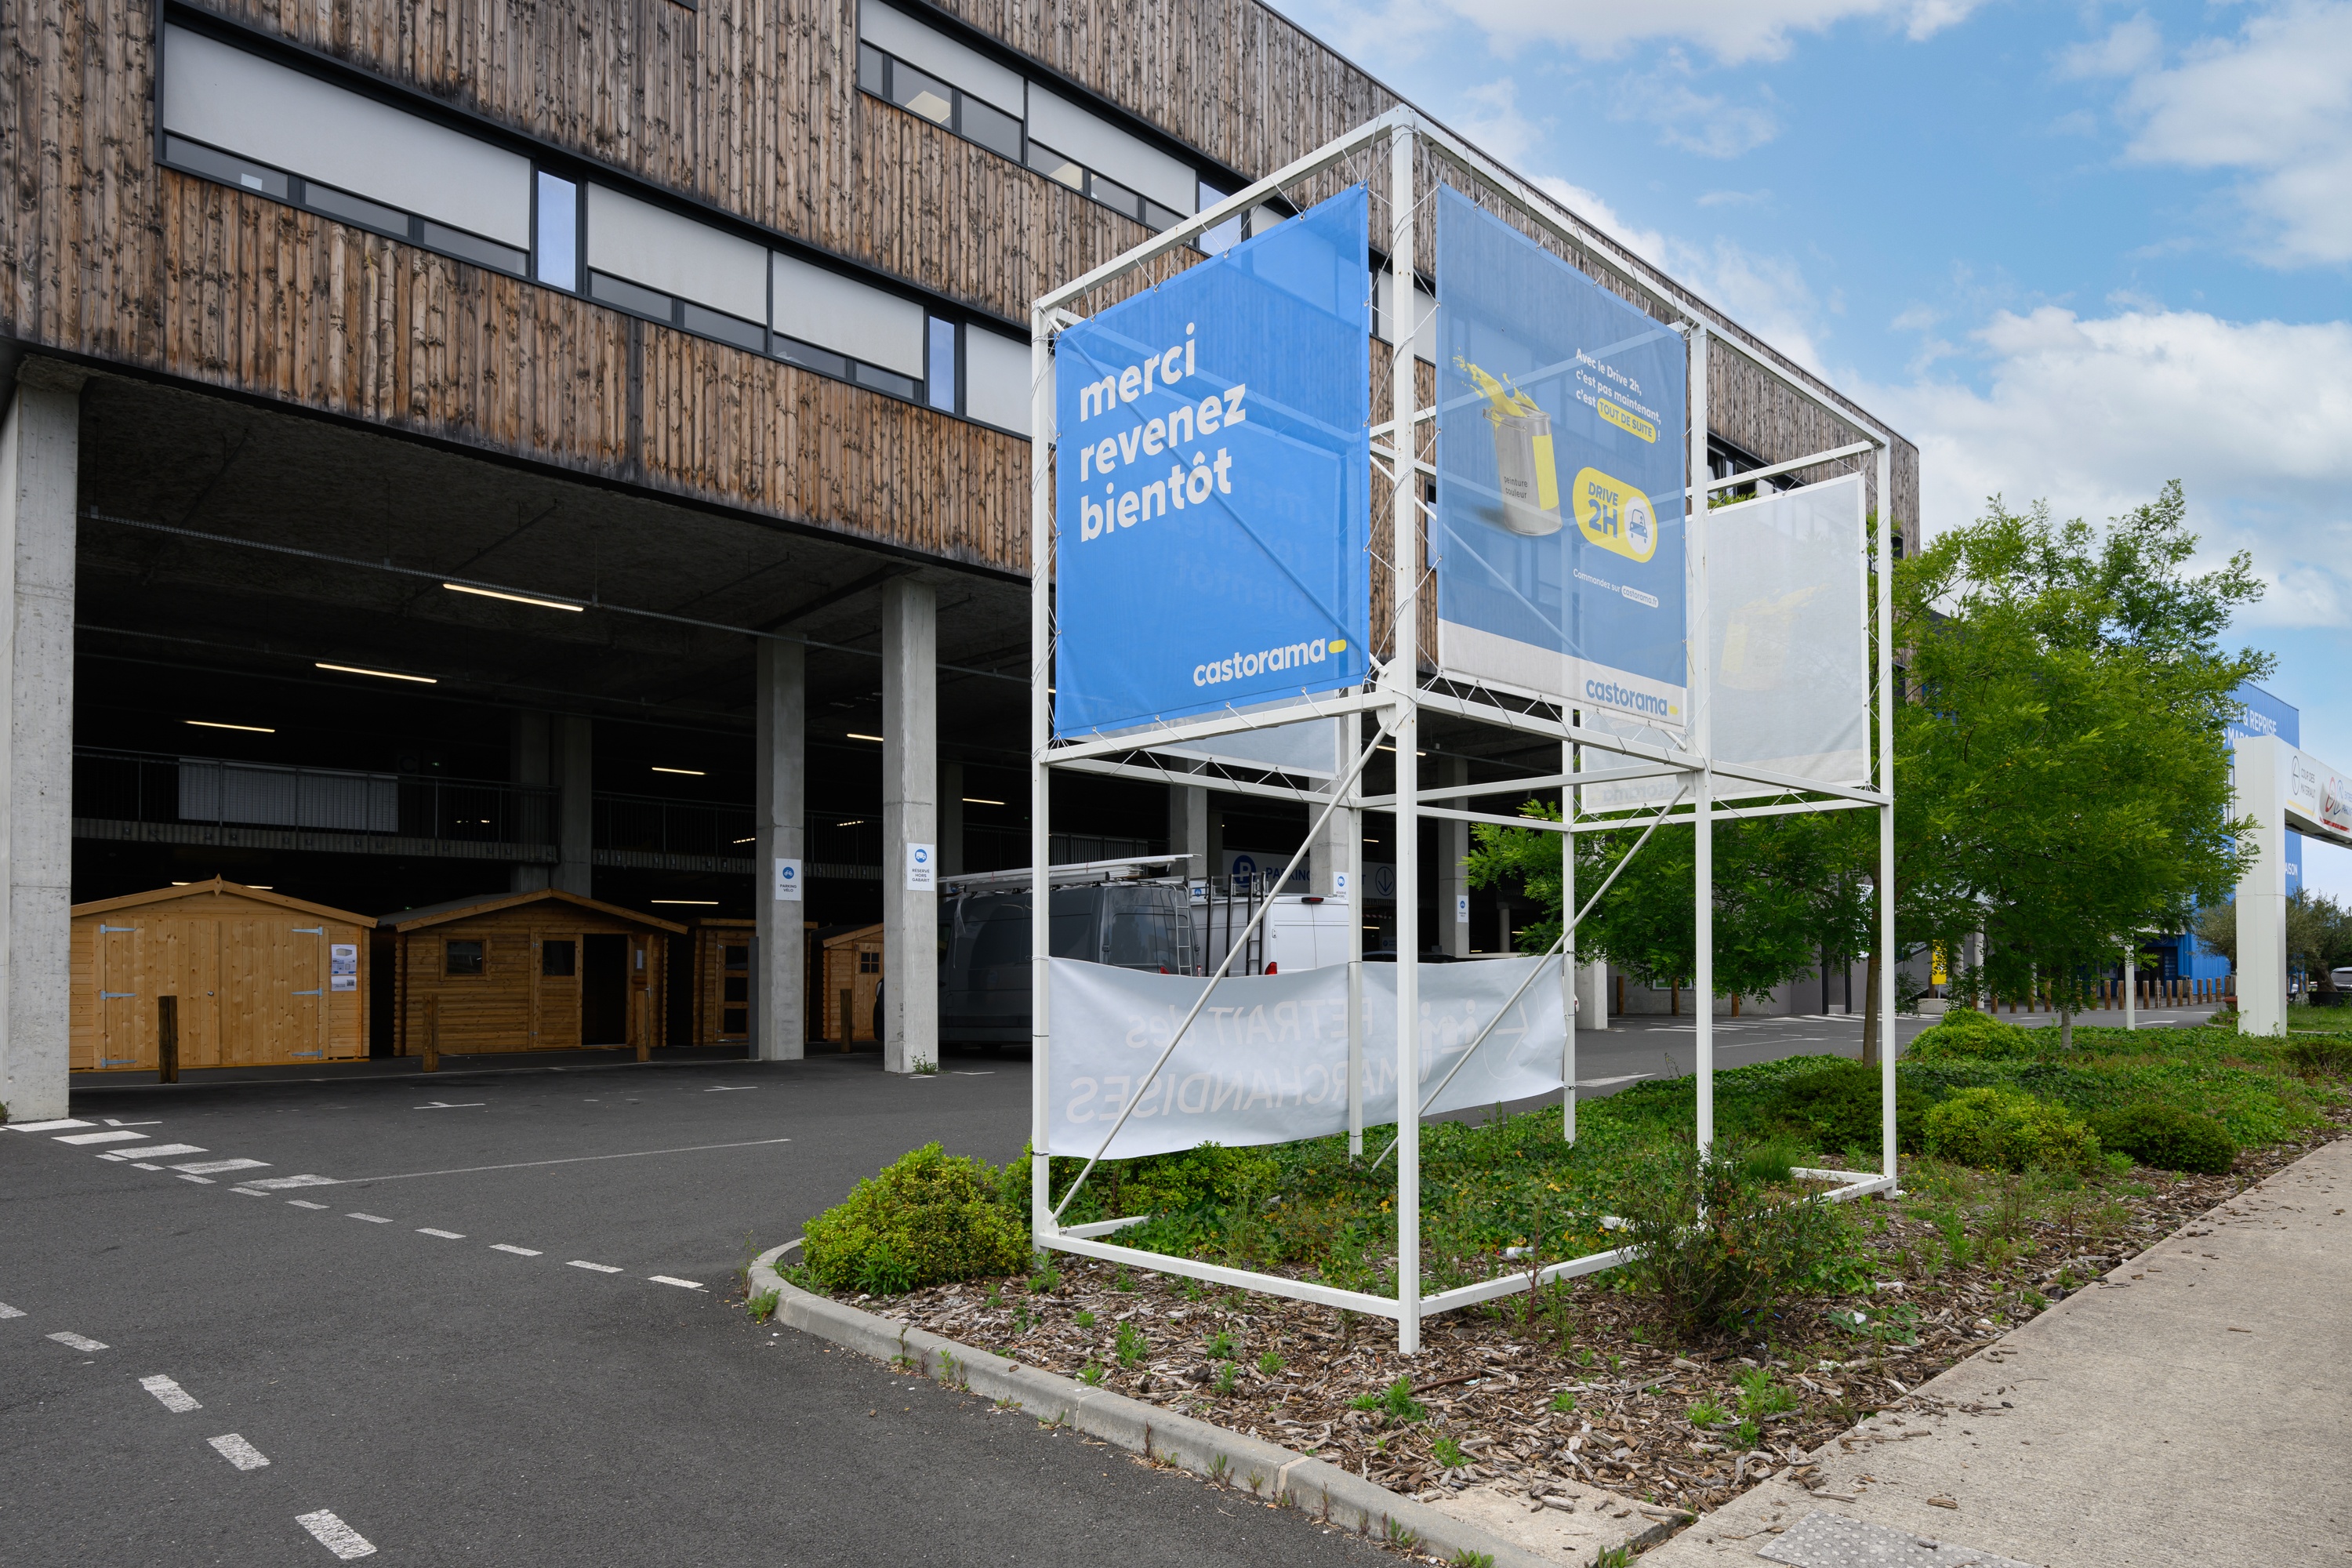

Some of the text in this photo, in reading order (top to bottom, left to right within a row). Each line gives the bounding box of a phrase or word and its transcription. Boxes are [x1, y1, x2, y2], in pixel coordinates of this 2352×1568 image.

[1080, 321, 1196, 423] merci
[1576, 347, 1642, 397] Avec le Drive 2h,
[1576, 369, 1661, 426] c'est pas maintenant,
[1576, 389, 1596, 408] c'est
[1599, 401, 1620, 420] TOUT
[1621, 412, 1631, 426] DE
[1632, 419, 1653, 438] SUITE
[1080, 383, 1247, 483] revenez
[1080, 447, 1232, 543] bientôt
[1504, 476, 1528, 488] peinture
[1505, 487, 1527, 499] couleur
[1588, 481, 1619, 506] DRIVE
[1588, 498, 1618, 539] 2H
[1573, 568, 1657, 606] Commandez sur castorama.fr
[1192, 637, 1326, 687] castorama
[1585, 678, 1668, 717] castorama
[2249, 709, 2277, 735] REPRISE
